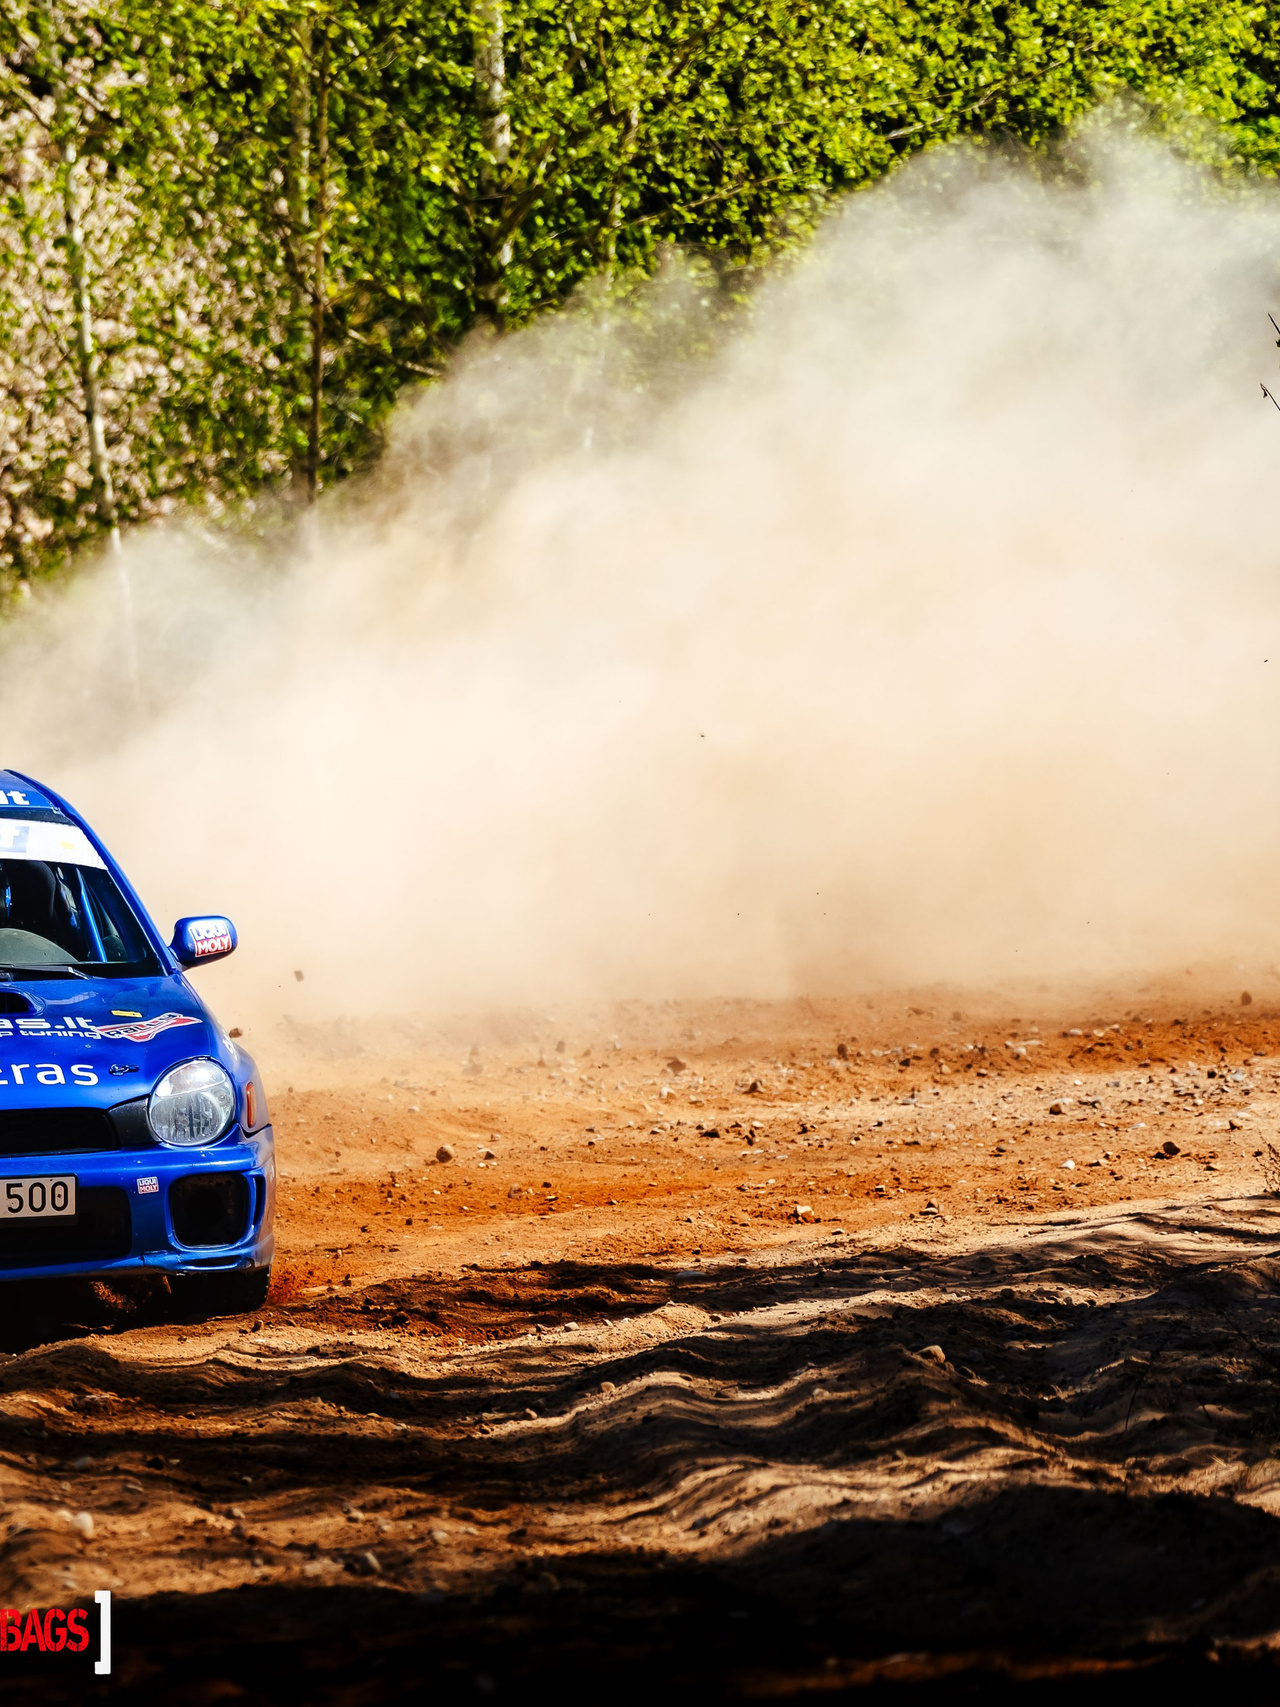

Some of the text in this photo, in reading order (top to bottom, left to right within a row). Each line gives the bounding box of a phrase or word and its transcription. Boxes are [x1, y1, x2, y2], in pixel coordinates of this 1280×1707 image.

[194, 922, 228, 939] LIQUI
[197, 936, 230, 954] MOLY
[20, 1030, 102, 1039] tuning
[139, 1178, 157, 1186] LIQUI
[140, 1185, 157, 1193] MOLY
[5, 1181, 69, 1213] 500
